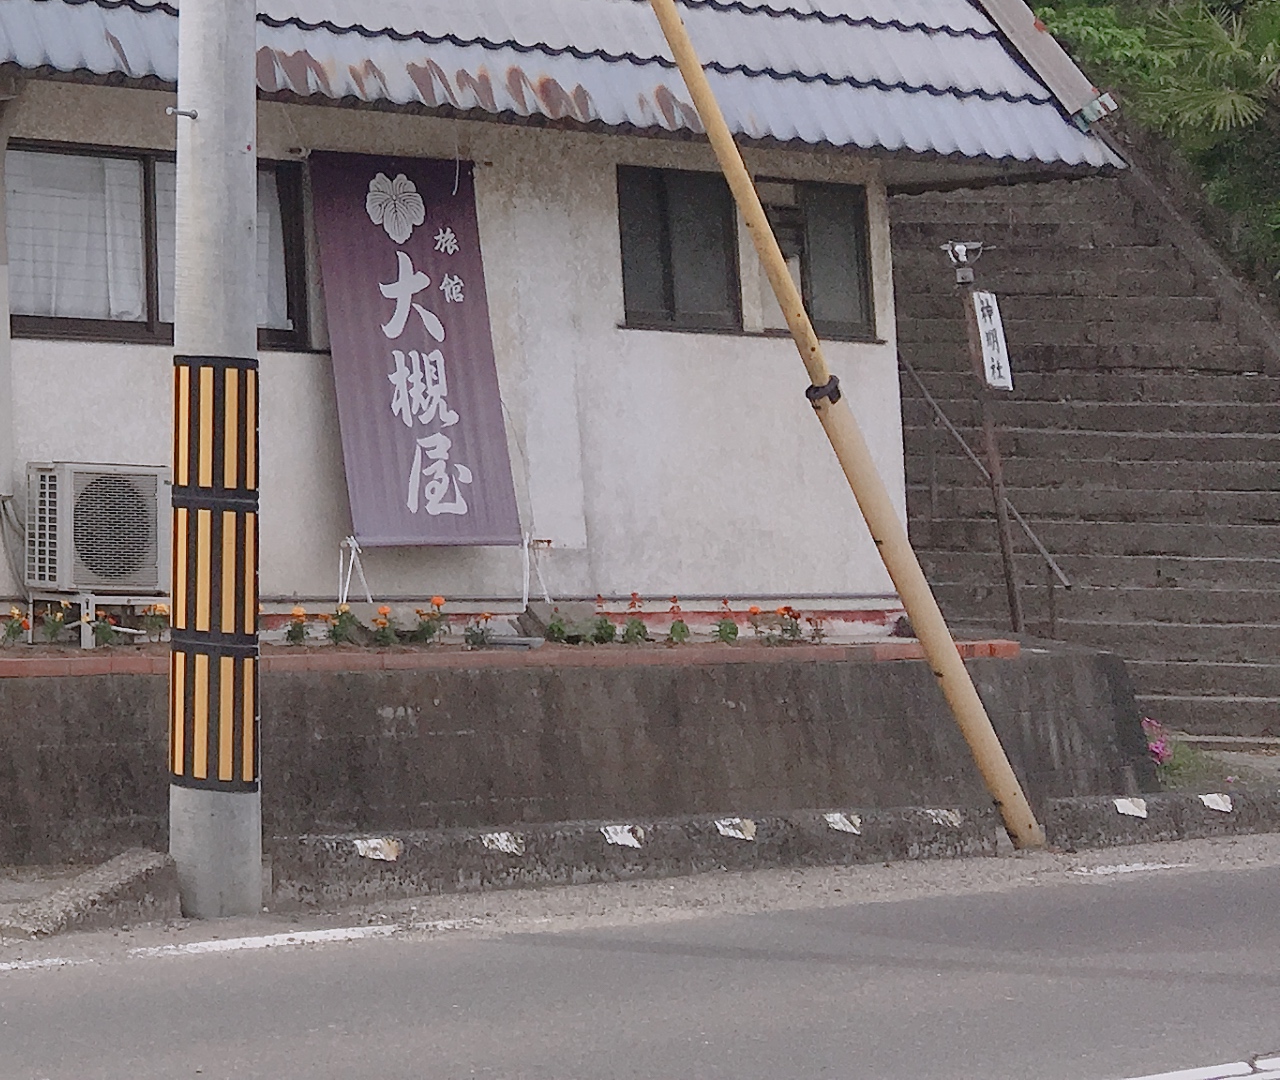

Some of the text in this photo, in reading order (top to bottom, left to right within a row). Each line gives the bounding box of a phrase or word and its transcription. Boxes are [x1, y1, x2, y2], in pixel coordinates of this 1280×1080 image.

[433, 227, 465, 305] 旅館
[978, 293, 1006, 381] 神明社
[378, 250, 473, 516] 大槻屋
